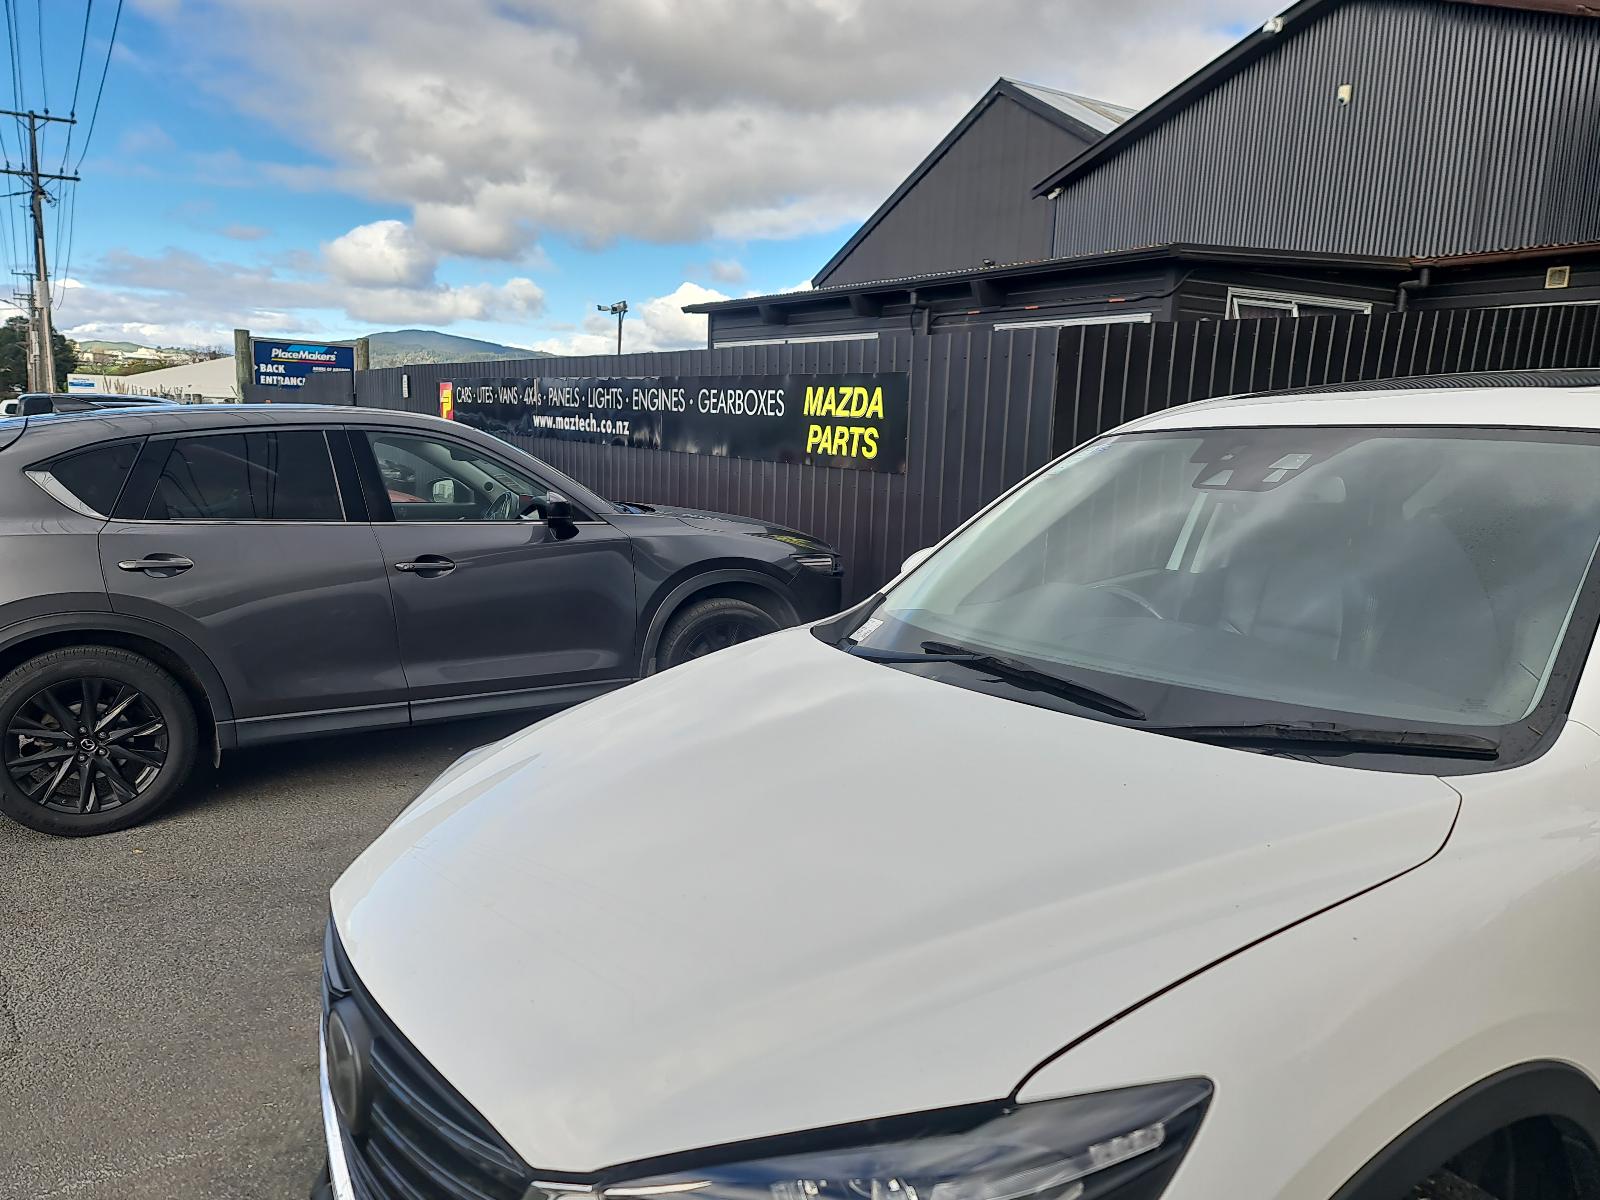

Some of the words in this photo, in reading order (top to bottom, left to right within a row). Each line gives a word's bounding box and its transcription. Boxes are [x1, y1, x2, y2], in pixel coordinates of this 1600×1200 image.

[271, 348, 336, 361] PlaceMakers
[259, 363, 286, 374] BACK
[260, 375, 306, 386] ENTRANC
[456, 386, 473, 404] CARS
[477, 386, 494, 404] UTES
[498, 386, 518, 405] VANS
[548, 387, 580, 408] PANELS
[588, 387, 623, 410] LIGHTS
[632, 388, 686, 412] ENGINES
[698, 389, 785, 417] GEARBOXES
[803, 386, 884, 419] MAZDA
[533, 413, 630, 435] www.maztech.co.nz
[806, 424, 880, 459] PARTS
